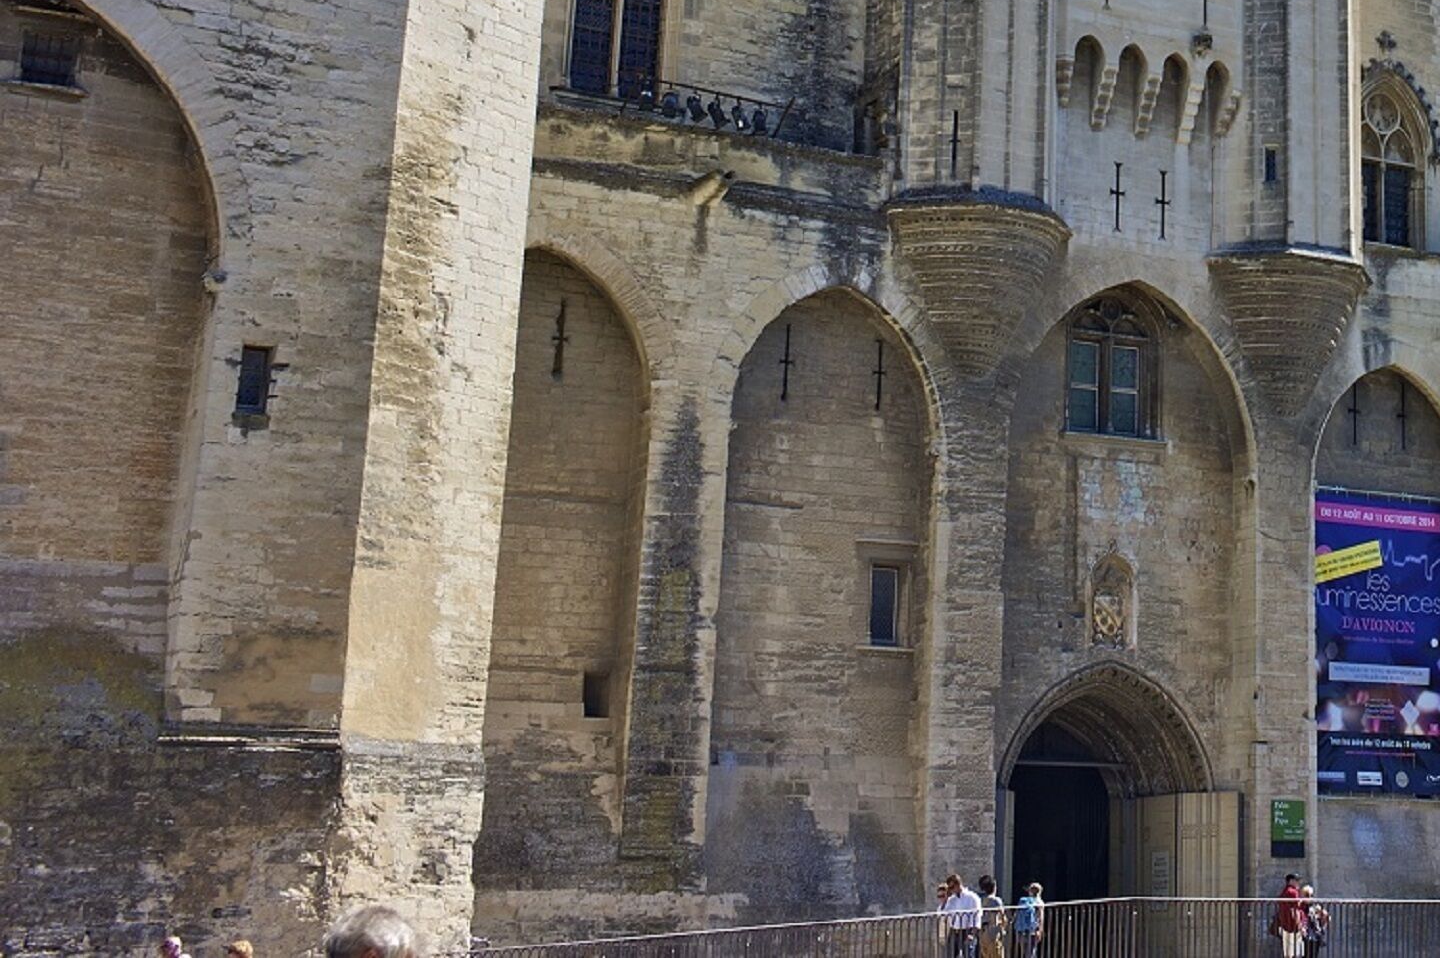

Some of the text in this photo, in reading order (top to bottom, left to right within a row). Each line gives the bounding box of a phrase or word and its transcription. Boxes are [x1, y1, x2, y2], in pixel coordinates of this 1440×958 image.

[1384, 516, 1417, 526] OCTOBRE
[1368, 570, 1390, 591] les
[1342, 617, 1416, 633] D'AVIGNON
